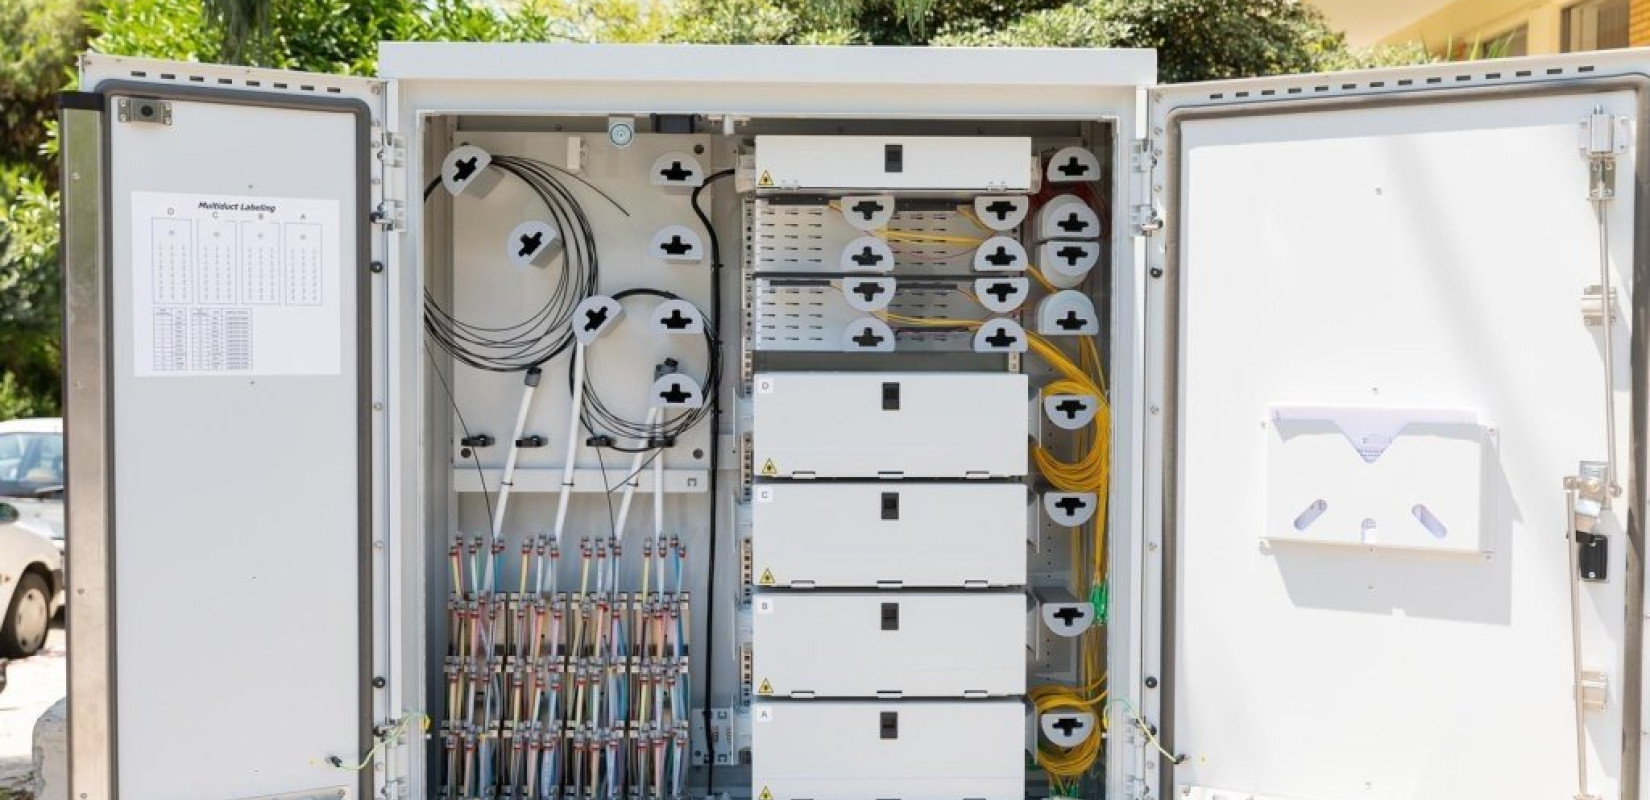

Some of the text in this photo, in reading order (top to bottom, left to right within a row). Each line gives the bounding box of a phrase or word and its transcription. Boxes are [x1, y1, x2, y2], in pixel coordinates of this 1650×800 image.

[198, 202, 276, 213] Multiduct Labeling
[762, 381, 769, 390] D
